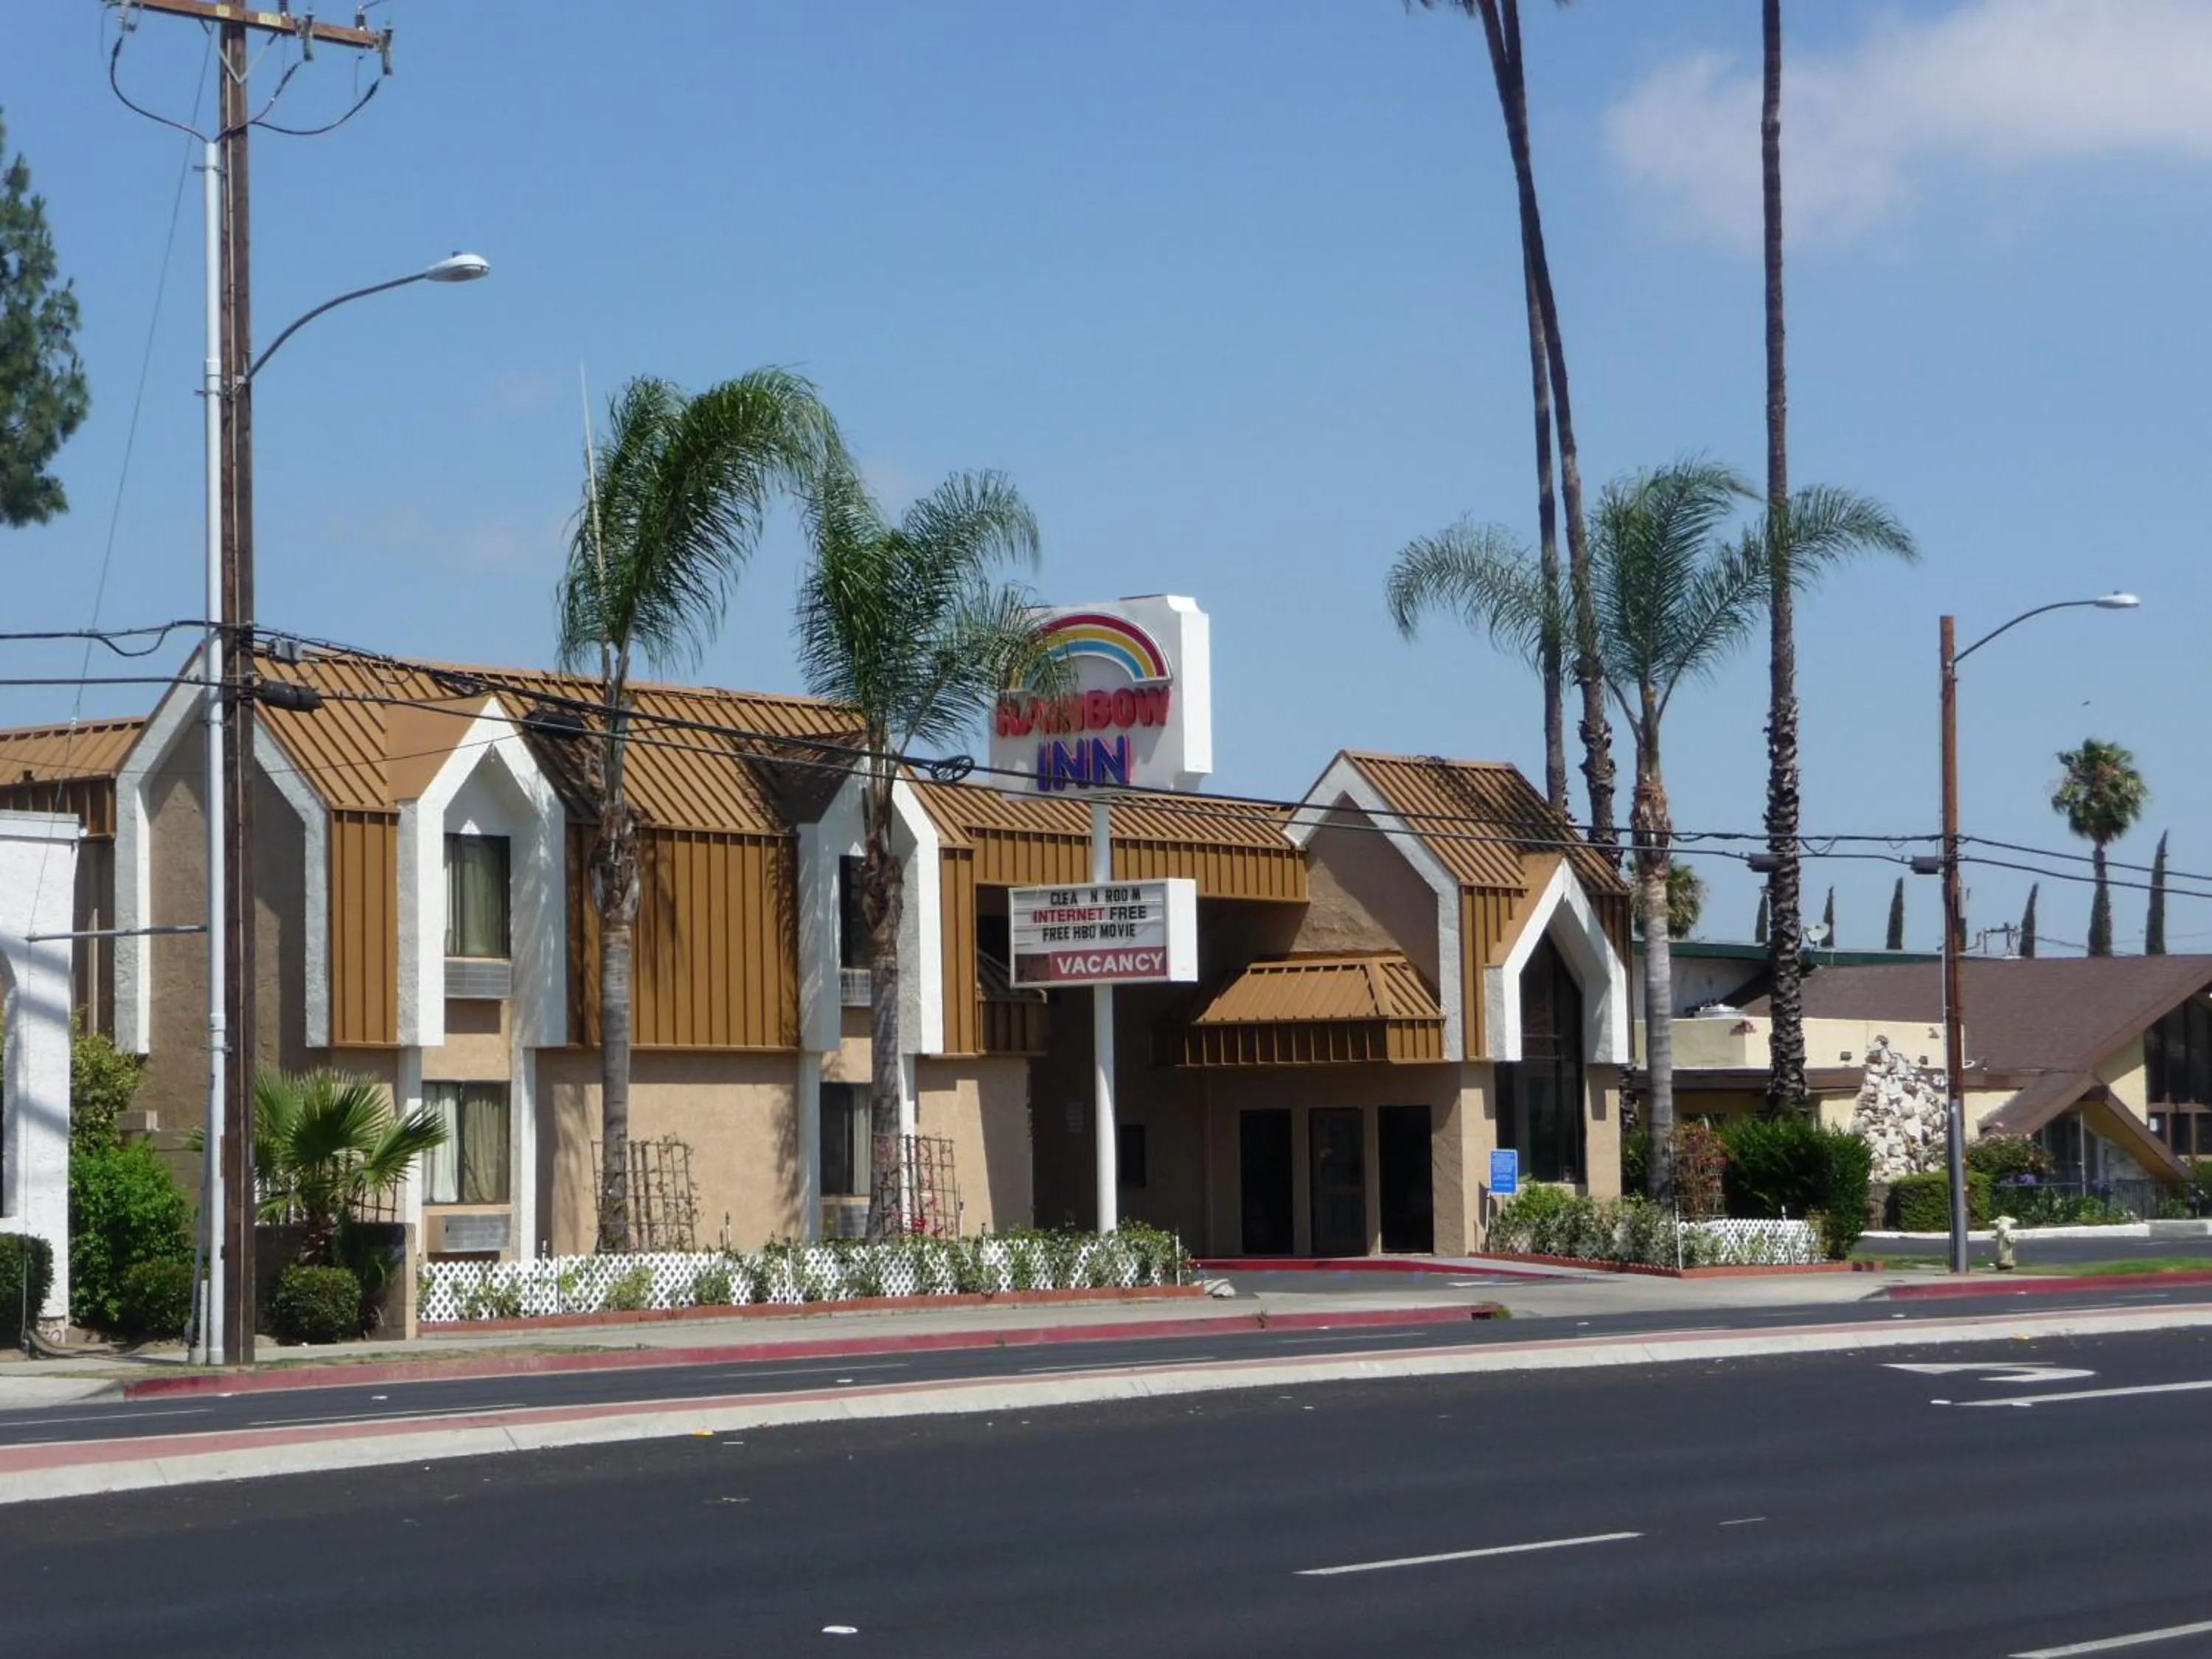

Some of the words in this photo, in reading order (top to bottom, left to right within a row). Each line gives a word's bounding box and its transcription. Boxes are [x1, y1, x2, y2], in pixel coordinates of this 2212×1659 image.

[1037, 735, 1130, 792] INN
[1033, 908, 1105, 923] INTERNET
[1110, 905, 1147, 920] FREE
[1042, 926, 1070, 942] FREE
[1074, 925, 1096, 939] HBO
[1099, 923, 1136, 939] MOVIE
[1057, 953, 1162, 974] VACANCY
